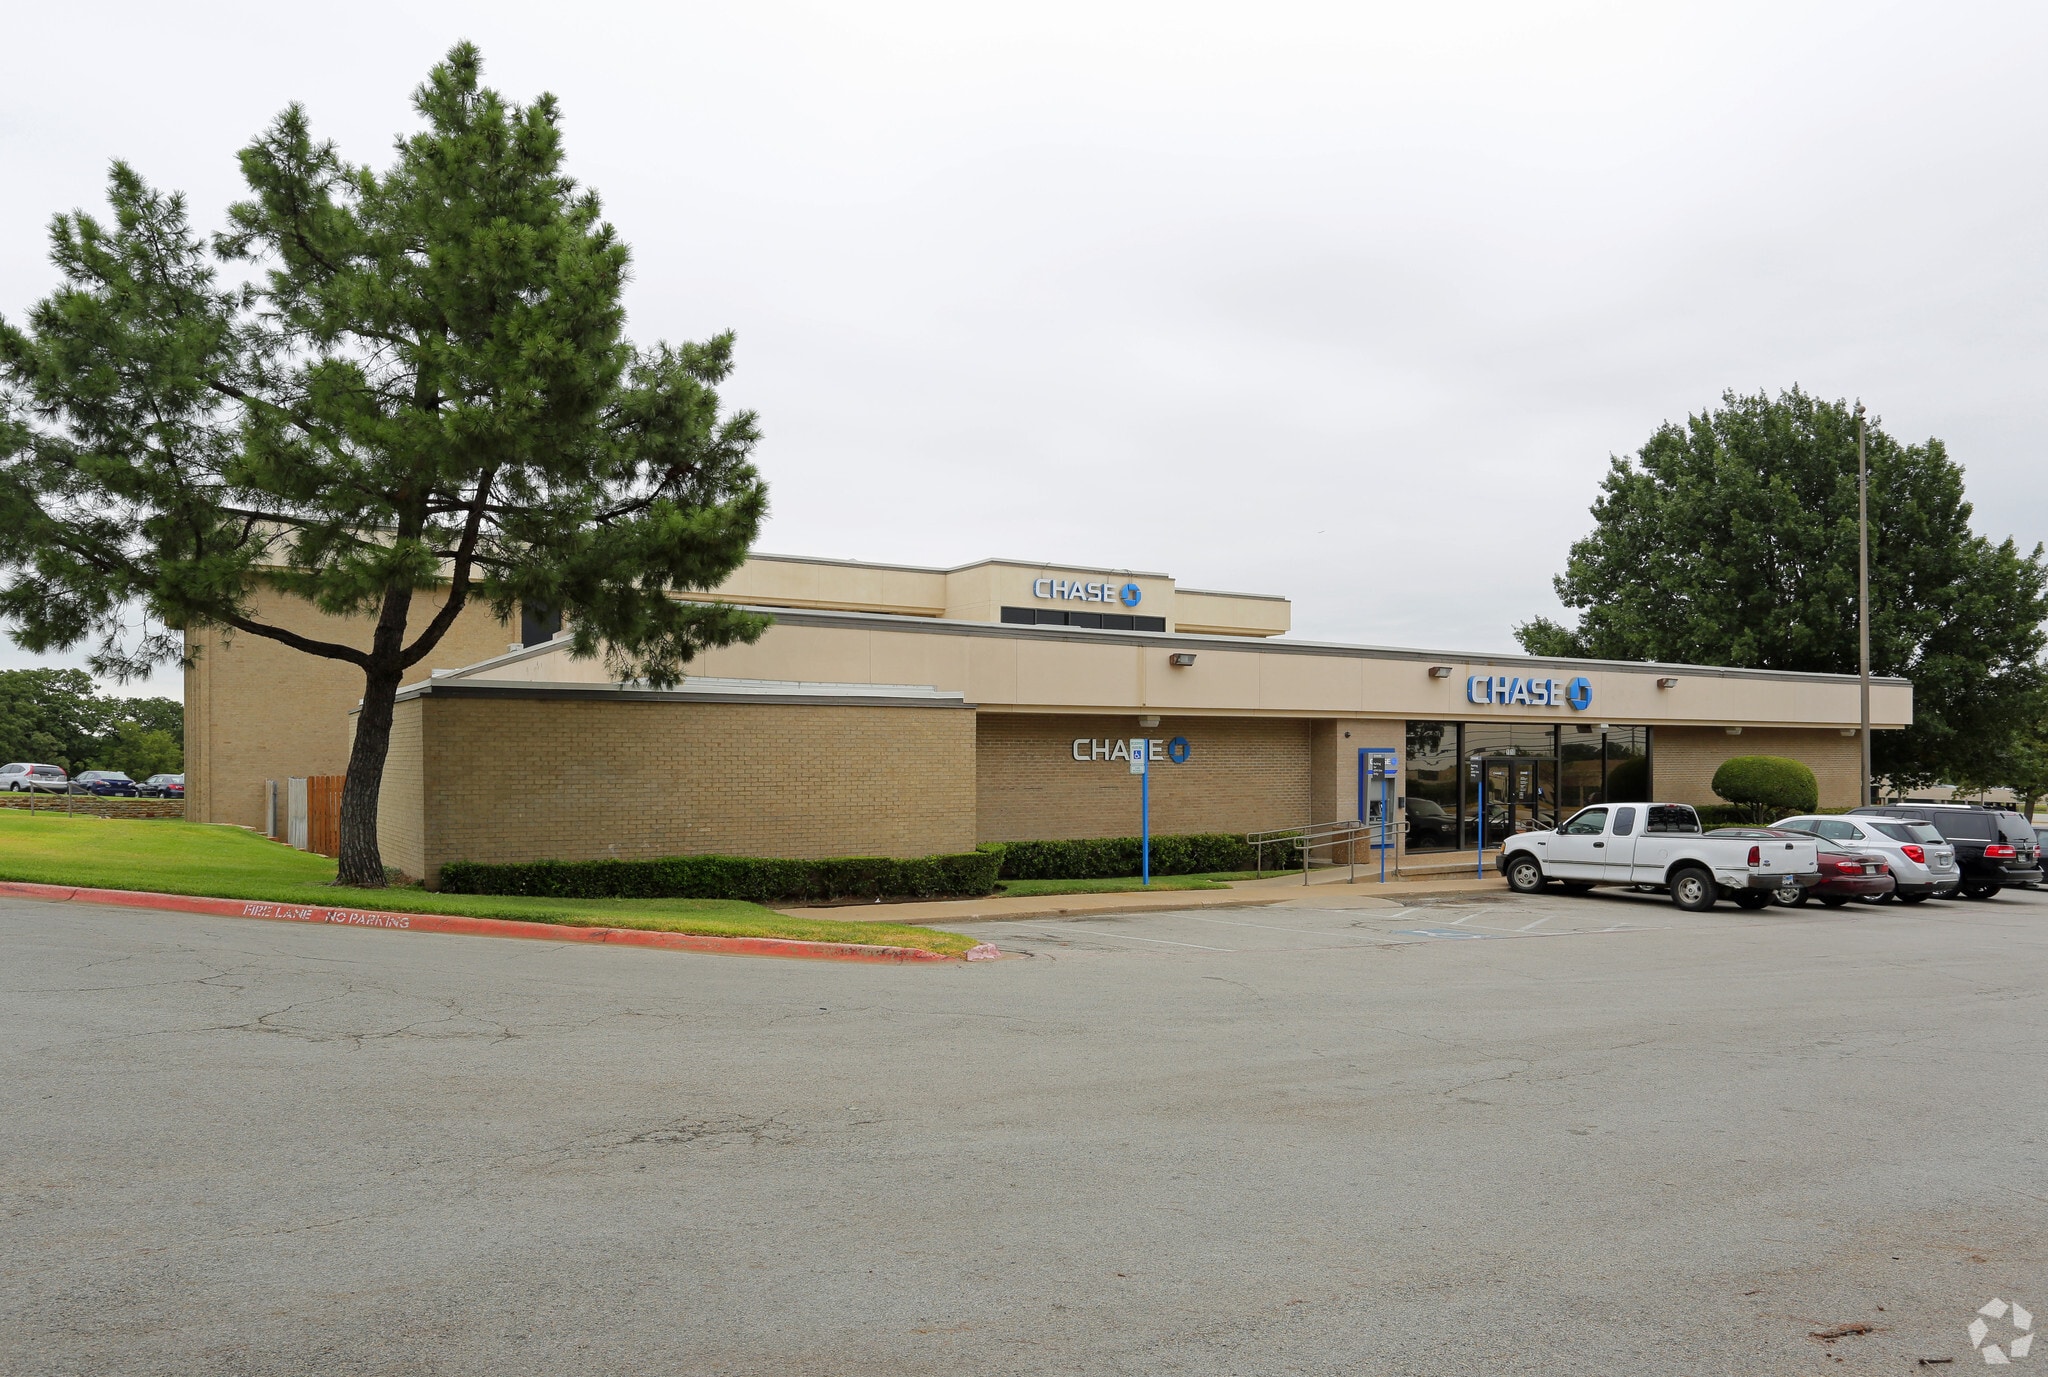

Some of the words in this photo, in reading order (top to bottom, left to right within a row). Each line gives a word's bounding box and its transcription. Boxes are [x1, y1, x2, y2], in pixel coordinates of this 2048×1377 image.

[1033, 578, 1117, 603] CHASE
[1467, 675, 1566, 706] CHASE
[1072, 738, 1165, 761] CHAE
[243, 904, 272, 917] FIRE
[275, 907, 313, 920] LANE
[325, 911, 347, 923] NO
[349, 913, 410, 929] PARKING
